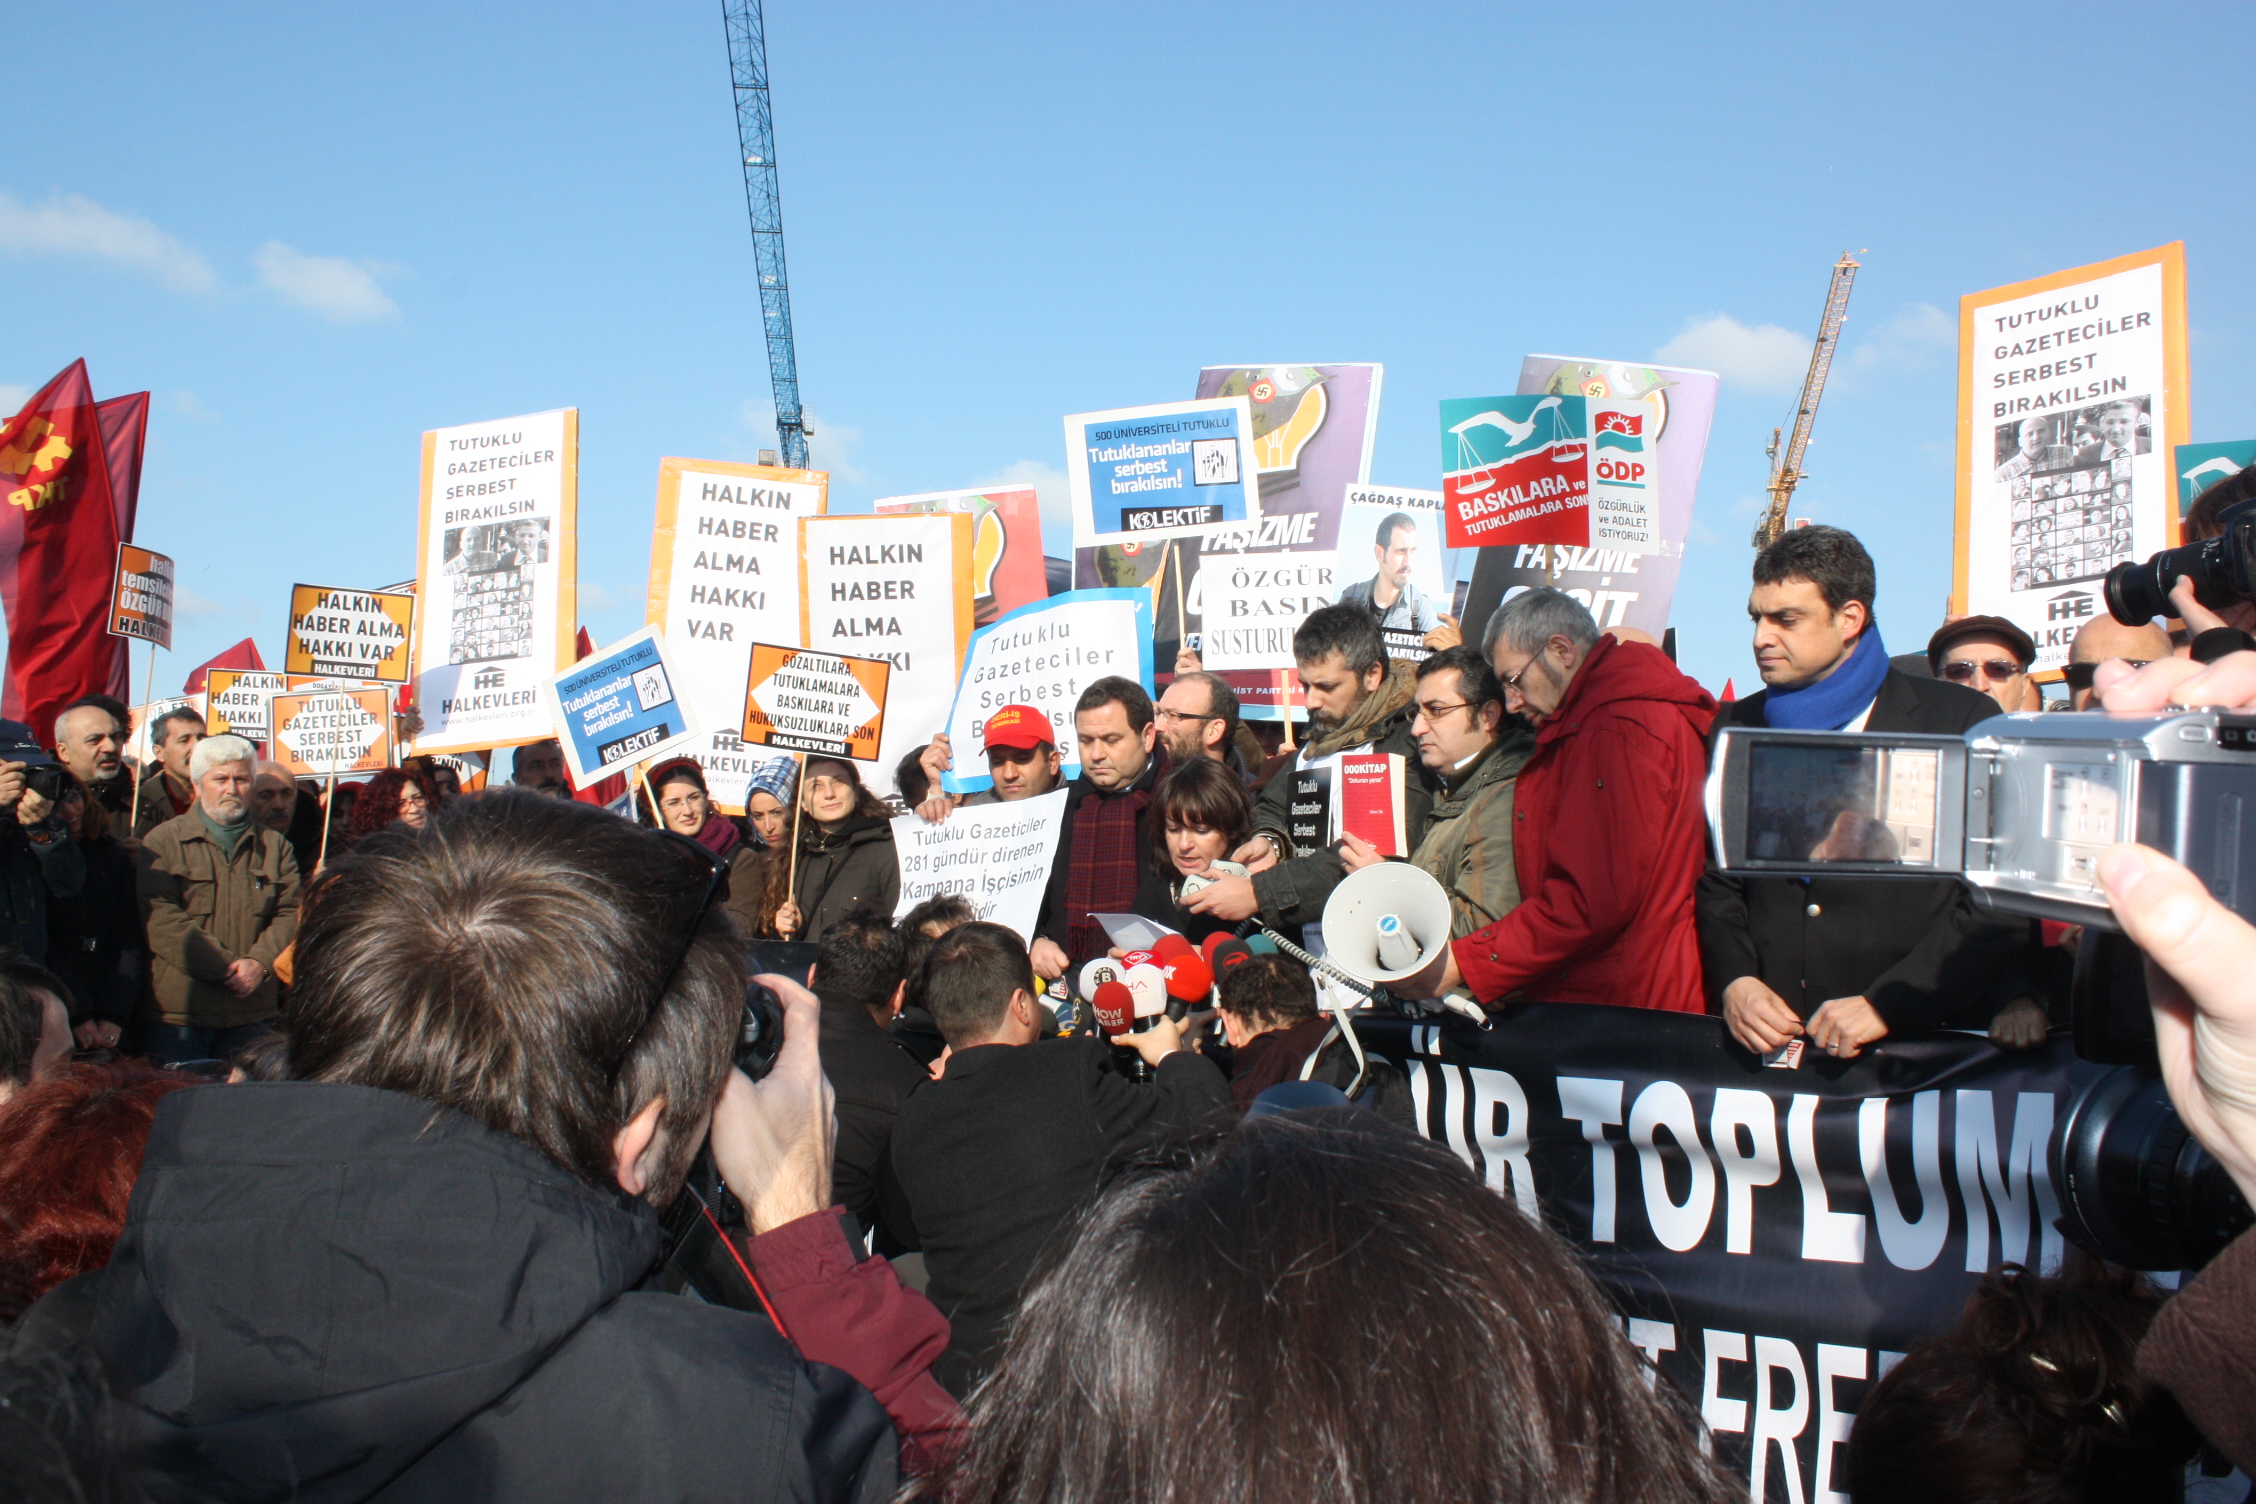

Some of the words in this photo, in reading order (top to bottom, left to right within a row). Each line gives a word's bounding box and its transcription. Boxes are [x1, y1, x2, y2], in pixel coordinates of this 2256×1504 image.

[1994, 294, 2100, 333] TUTUKLU
[1994, 311, 2152, 360] GAZETECİLER
[1993, 352, 2098, 389] SERBEST
[1994, 375, 2127, 418] BIRAKILSIN
[1095, 430, 1113, 441] 500
[1113, 420, 1181, 440] ÜNİVERSİTELİ
[1182, 417, 1230, 431] TUTUKLU
[450, 432, 522, 452] TUTUKLU
[1089, 439, 1191, 463] Tutuklananlar
[447, 450, 555, 476] GAZETECİLER
[1114, 459, 1168, 477] serbest
[1596, 458, 1646, 481] ÖDP
[446, 478, 517, 500] SERBEST
[1111, 471, 1183, 495] bırakılsın!
[701, 482, 792, 511] HALKIN
[1350, 491, 1403, 508] ÇAĞDAŞ
[1458, 474, 1570, 521] BASKILARA
[1573, 479, 1586, 492] ve
[1598, 497, 1647, 515] ÖZGÜRLÜK
[445, 499, 536, 525] BIRAKILSIN
[1464, 500, 1564, 536] TUTUKLAMALARA
[1598, 516, 1609, 526] ve
[1611, 515, 1648, 528] ADALET
[697, 516, 779, 543] HABER
[693, 551, 761, 575] ALMA
[829, 543, 923, 566] HALKIN
[1231, 564, 1333, 588] ÖZGÜR
[317, 591, 383, 614] HALKIN
[690, 585, 766, 611] HAKKI
[831, 580, 915, 602] HABER
[293, 613, 350, 635] HABER
[356, 621, 405, 640] ALMA
[687, 619, 734, 642] VAR
[831, 617, 903, 638] ALMA
[990, 622, 1070, 654] Tutuklu
[298, 638, 352, 659] HAKKI
[360, 643, 395, 661] VAR
[1211, 627, 1296, 656] SUSTURU
[1381, 631, 1424, 647] AZETECİ
[314, 663, 376, 678] HALKEVLERİ
[564, 682, 577, 695] 500
[620, 647, 653, 673] TUTUKLU
[974, 647, 1114, 684] Gazeteciler
[232, 675, 284, 689] HALKIN
[773, 673, 860, 699] TUTUKLAMALARA
[981, 677, 1077, 709] Serbest
[211, 692, 259, 706] HABER
[297, 697, 362, 713] TUTUKLU
[442, 686, 537, 714] HALKEVLERİ
[562, 675, 632, 715] Tutuklananlar
[776, 694, 834, 716] BASKILARA
[837, 699, 851, 717] VE
[217, 710, 262, 724] HAKKI
[441, 709, 536, 726] www.halkevleri.org.tr
[583, 696, 620, 721] serbest
[282, 711, 378, 731] GAZETECİLER
[583, 705, 634, 737] bırakılsın!
[749, 710, 850, 739] HUKUKSUZLUKLARA
[853, 724, 875, 741] SON
[299, 729, 363, 746] SERBEST
[771, 733, 846, 755] HALKEVLERİ
[290, 745, 371, 763] BIRAKILSIN
[344, 759, 384, 769] HALKEVLERİ
[913, 826, 965, 846] Tutuklu
[970, 817, 1047, 840] Gazeticiler
[904, 854, 928, 873] 281
[933, 848, 988, 873] gündür
[992, 841, 1044, 864] direnen
[902, 877, 975, 900] Kampana
[981, 864, 1044, 897] İşçisinin
[1557, 1076, 2065, 1277] TOPLUM
